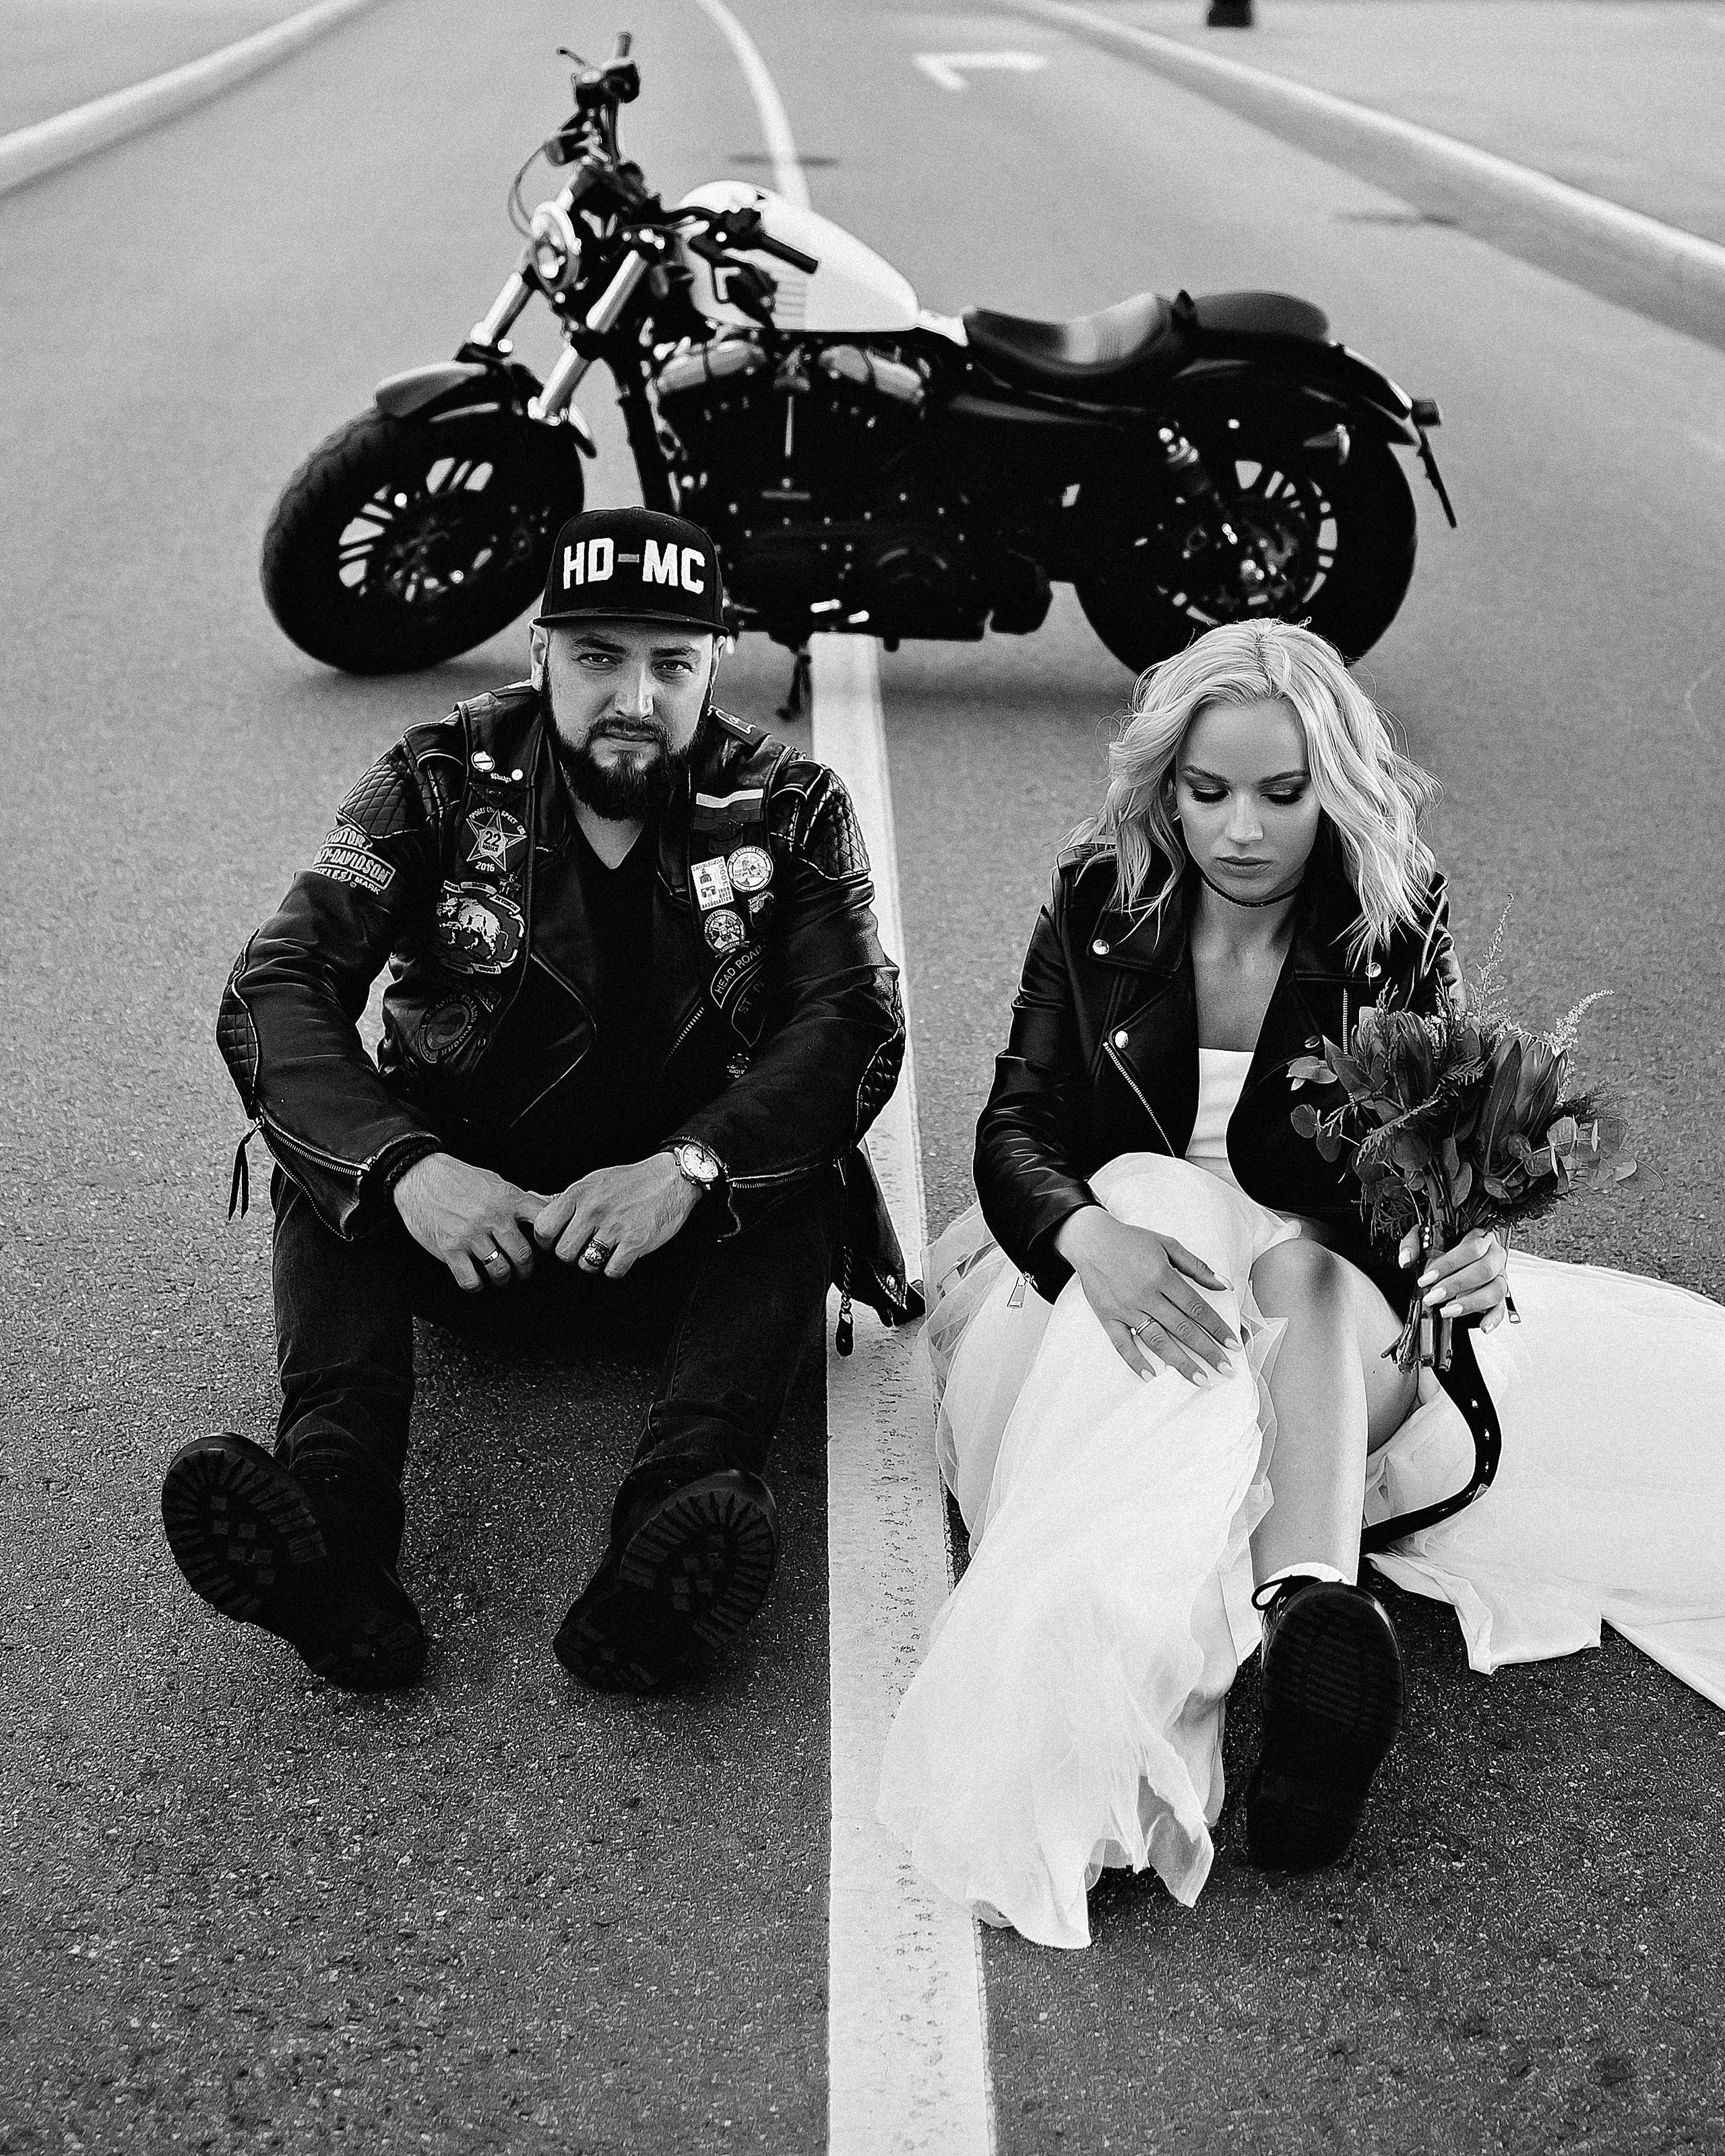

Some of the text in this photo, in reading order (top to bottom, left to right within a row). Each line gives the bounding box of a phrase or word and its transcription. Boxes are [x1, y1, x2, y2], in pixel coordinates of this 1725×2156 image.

[563, 538, 705, 594] HD-MC
[483, 830, 501, 848] 22
[475, 861, 495, 872] 2016
[354, 877, 381, 895] MARK
[714, 968, 736, 994] HEAD
[735, 945, 761, 969] ROAD
[738, 997, 752, 1013] ST
